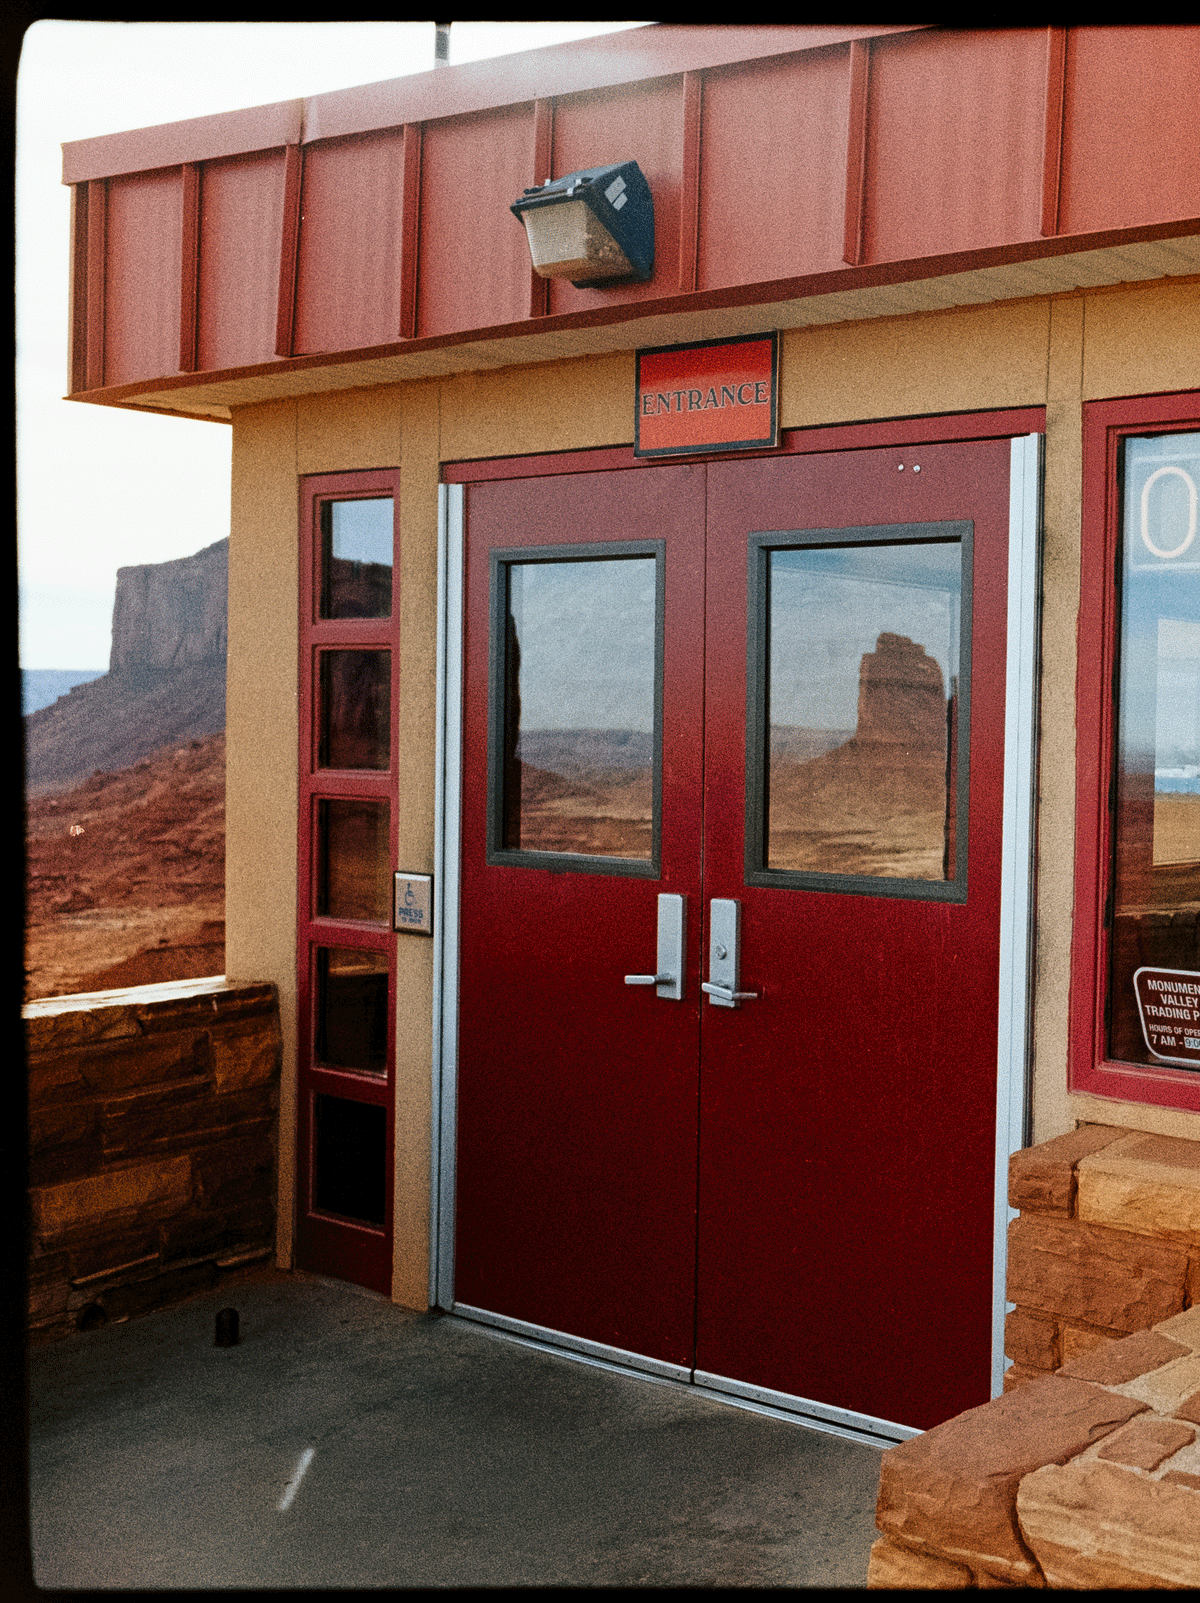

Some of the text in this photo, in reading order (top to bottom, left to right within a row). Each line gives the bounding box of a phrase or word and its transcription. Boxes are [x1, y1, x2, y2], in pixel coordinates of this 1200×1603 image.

[641, 380, 769, 416] ENTRANCE
[398, 906, 424, 919] PRESS
[1160, 993, 1199, 1009] VALLEY
[1144, 1004, 1191, 1020] TRADING
[1148, 1023, 1173, 1034] HOURS
[1173, 1026, 1183, 1035] OF
[1151, 1034, 1158, 1045] 7
[1160, 1035, 1177, 1047] AM
